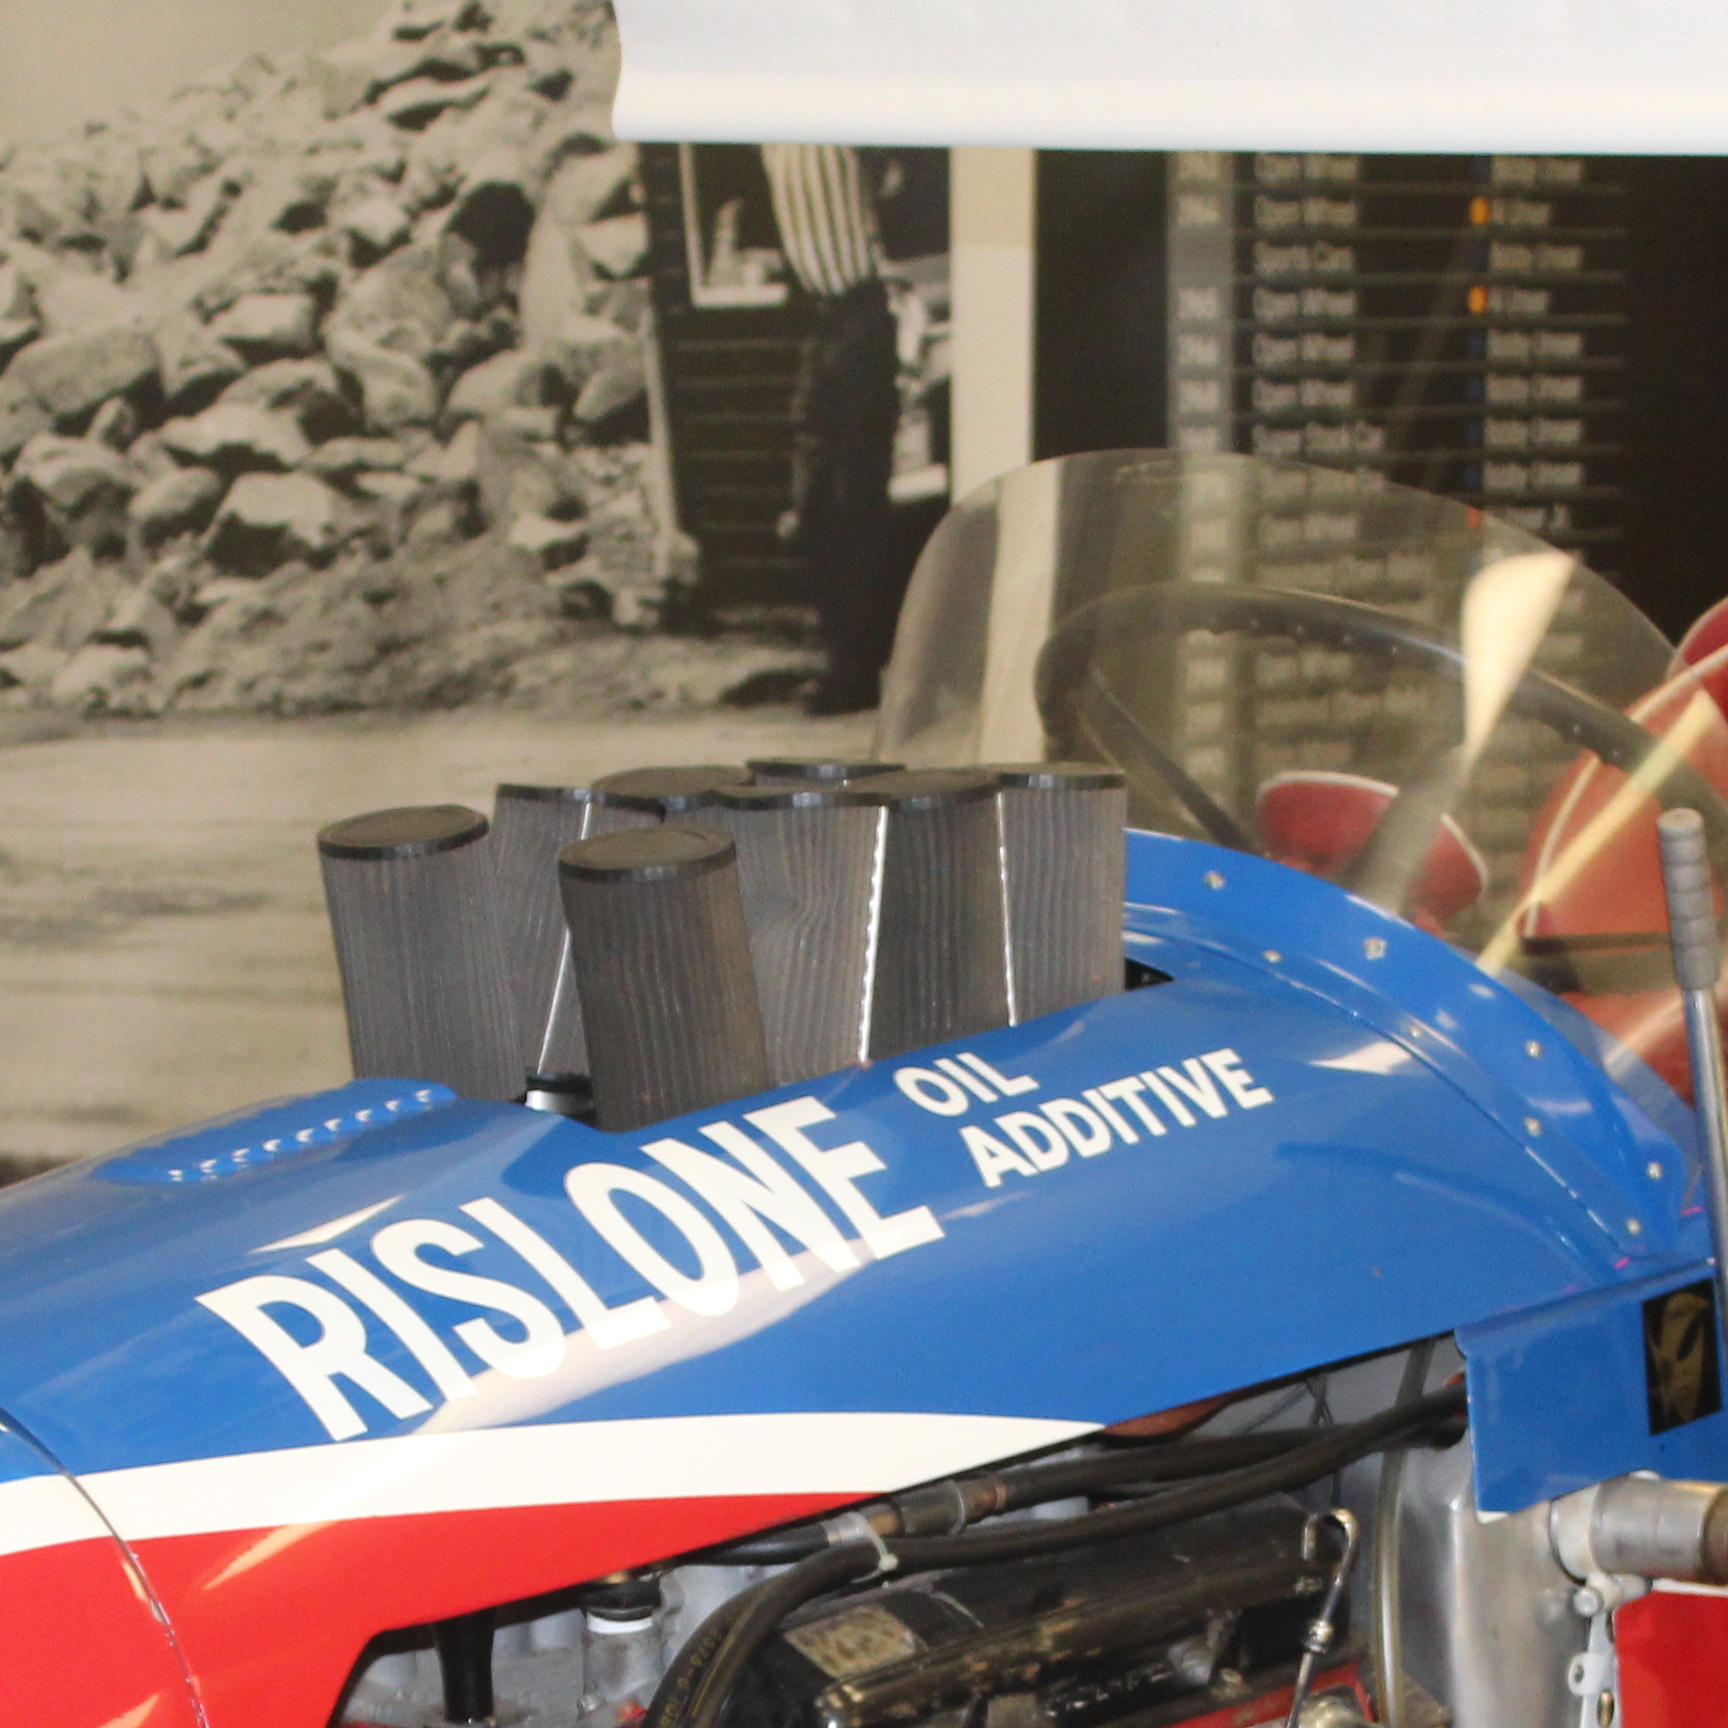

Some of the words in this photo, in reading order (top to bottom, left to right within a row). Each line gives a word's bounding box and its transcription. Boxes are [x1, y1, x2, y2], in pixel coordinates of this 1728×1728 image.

[891, 1051, 1039, 1117] OIL
[955, 1048, 1275, 1188] ADDITIVE
[196, 1096, 946, 1442] RISLONE
